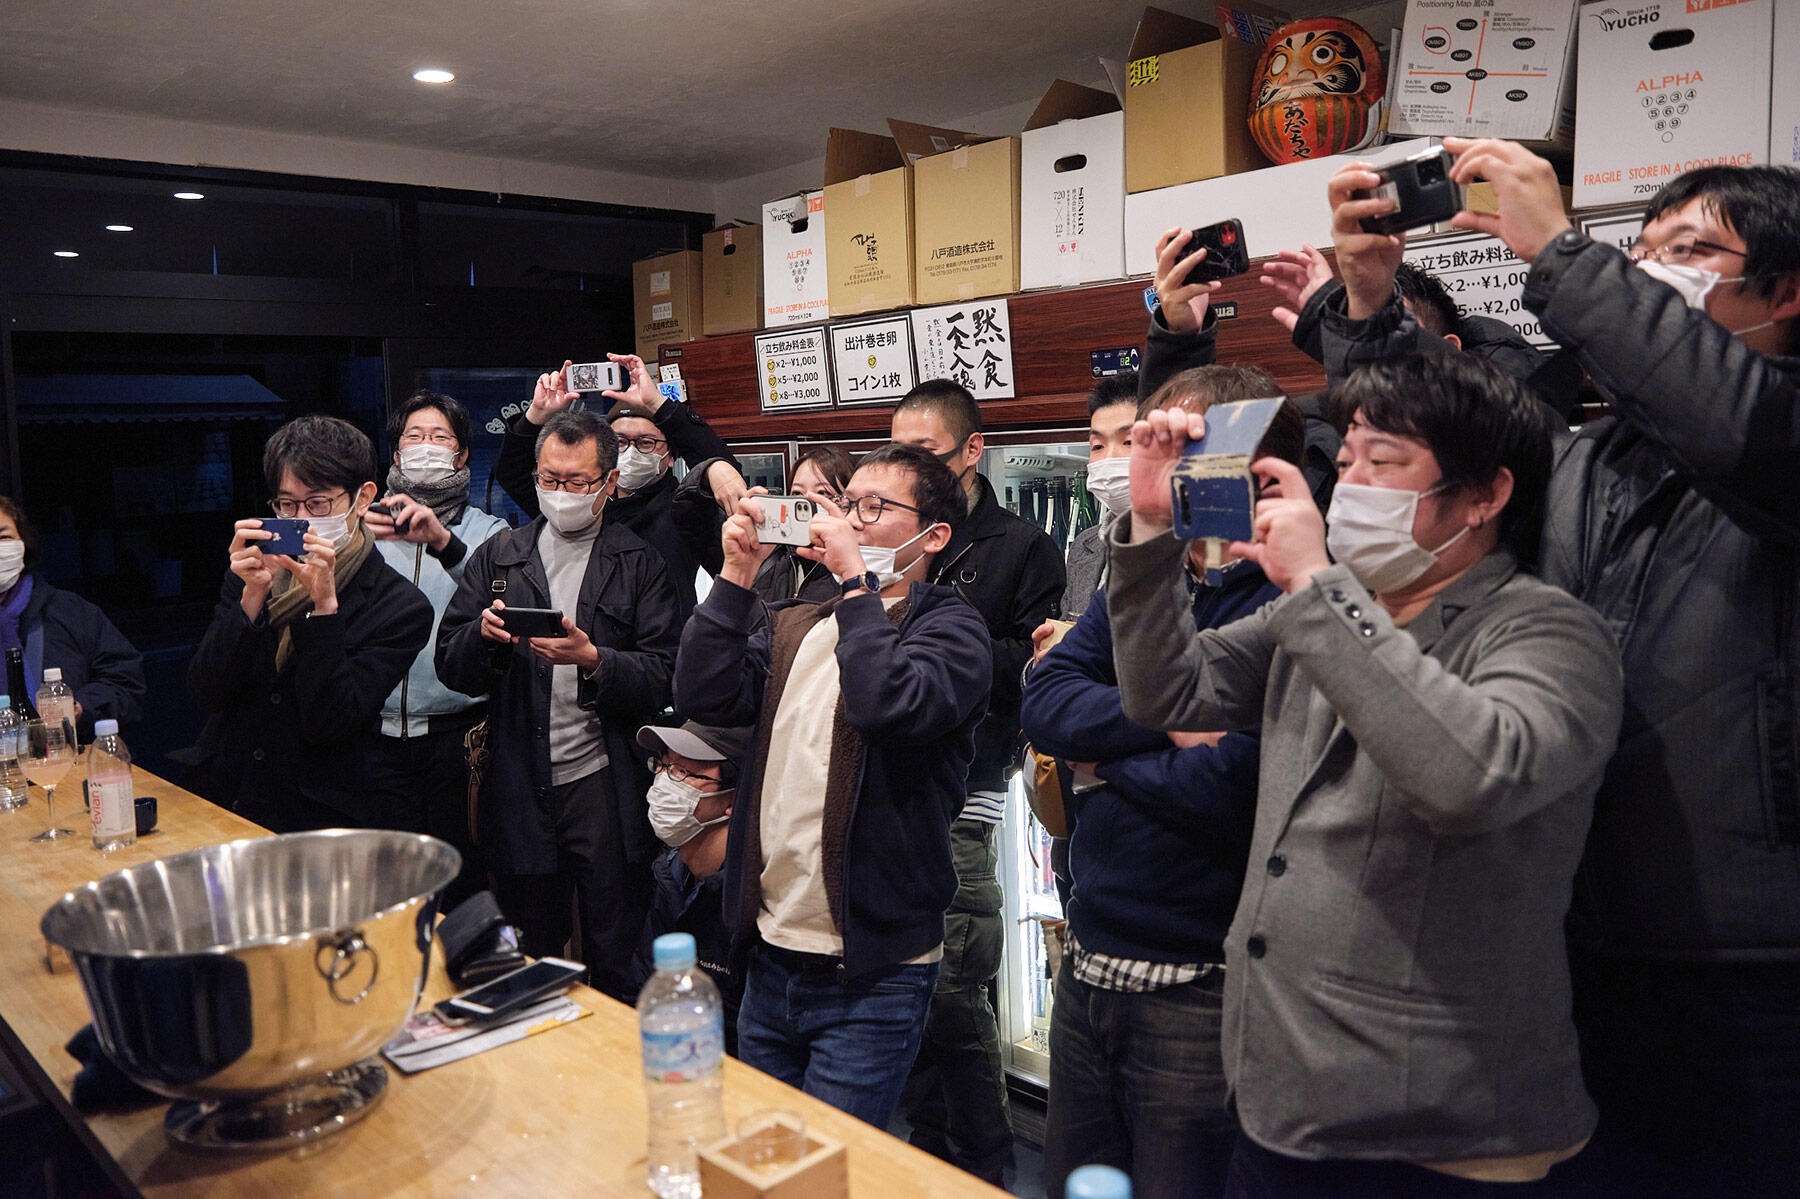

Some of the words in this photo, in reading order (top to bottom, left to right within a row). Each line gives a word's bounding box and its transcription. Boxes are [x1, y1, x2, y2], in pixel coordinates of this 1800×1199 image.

[1456, 0, 1472, 8] Map
[1607, 12, 1660, 31] YUCHO
[1635, 70, 1704, 93] ALPHA
[1283, 101, 1311, 159] あだちや
[1584, 170, 1622, 186] FRAGILE
[1629, 165, 1659, 180] STORE
[1660, 164, 1671, 176] IN
[1673, 163, 1682, 175] A
[1053, 190, 1066, 200] 720
[786, 247, 813, 260] ALPHA
[931, 239, 996, 260] 八戸酒造株式会社
[765, 337, 815, 354] 立ち飲み料金表
[845, 330, 897, 351] 出汁巻き卵
[972, 307, 1009, 390] 黙食
[848, 371, 902, 391] コイン1枚
[91, 789, 103, 825] evian
